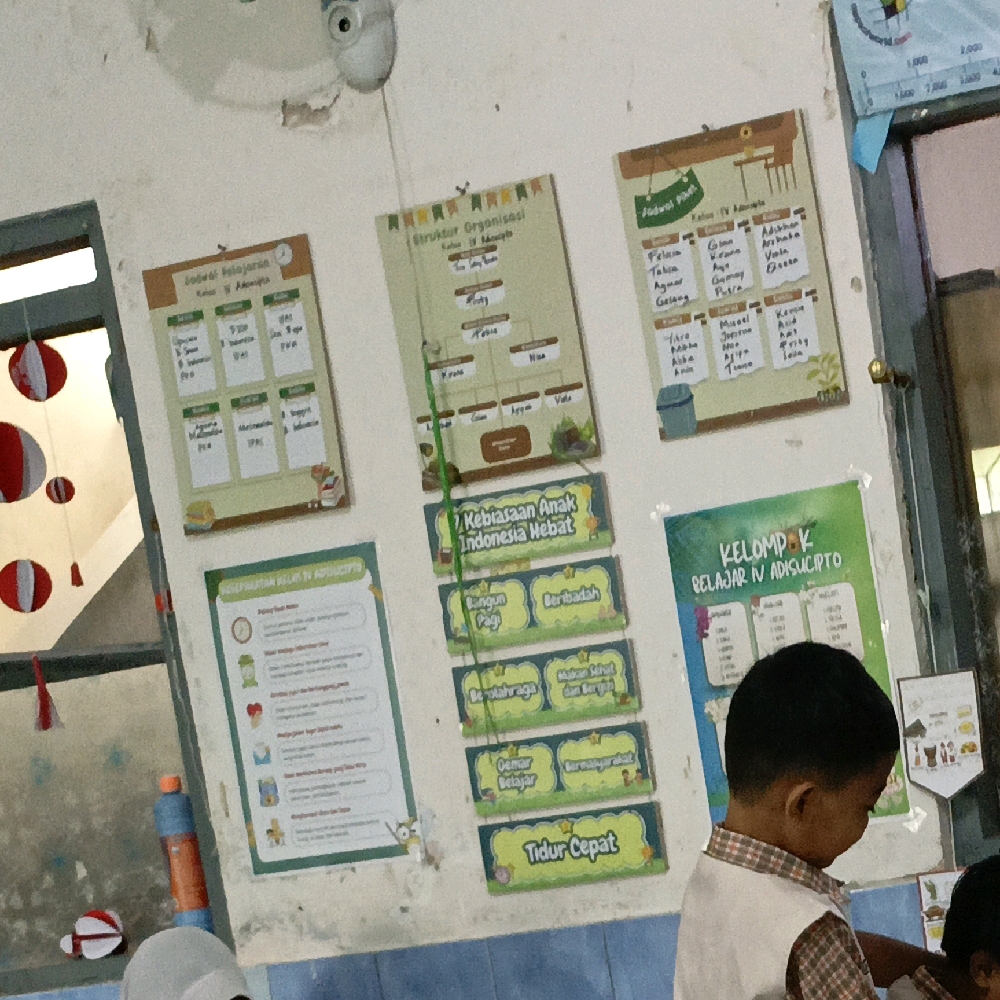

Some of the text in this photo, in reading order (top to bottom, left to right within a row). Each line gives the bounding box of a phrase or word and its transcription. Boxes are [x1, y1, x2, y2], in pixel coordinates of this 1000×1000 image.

[412, 208, 526, 246] Struktur Organisasi
[464, 504, 536, 529] Kebiasaan
[539, 494, 577, 514] Anak
[458, 518, 575, 552] Indonesia Hebat
[691, 551, 842, 594] BELAJAR IV ADISUCIPTO
[544, 588, 601, 607] Beribadah
[476, 612, 501, 630] Pagi
[525, 831, 618, 863] Tidur Cepat
